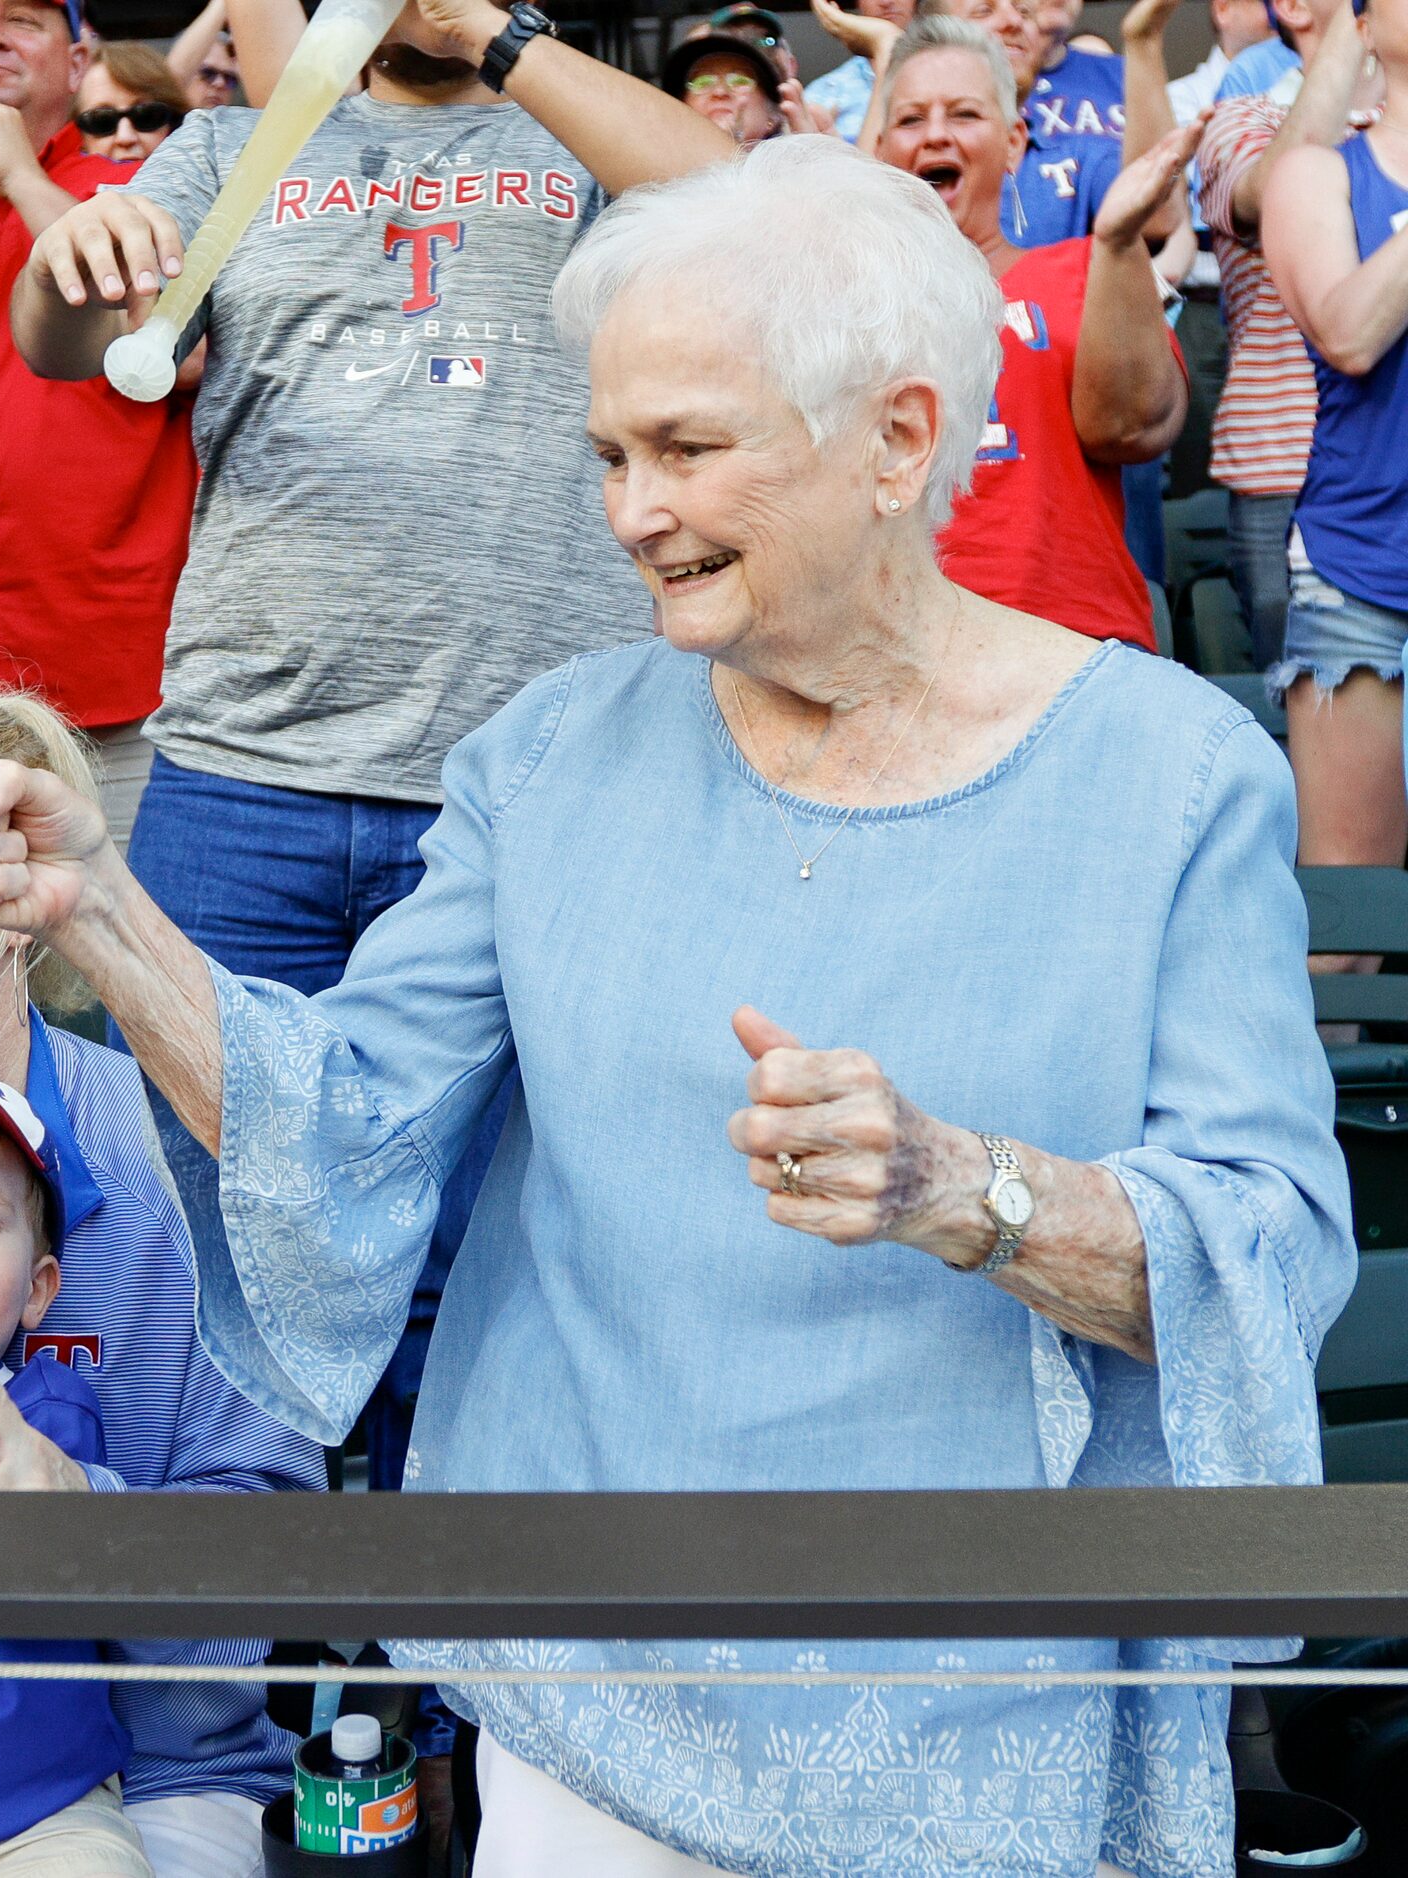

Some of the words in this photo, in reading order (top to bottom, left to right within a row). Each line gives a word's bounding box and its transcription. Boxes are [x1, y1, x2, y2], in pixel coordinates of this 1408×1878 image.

[1020, 98, 1126, 137] XAS
[272, 168, 578, 227] RANGERS
[1039, 157, 1078, 198] T
[383, 219, 465, 318] T
[309, 319, 527, 345] BASEBALL
